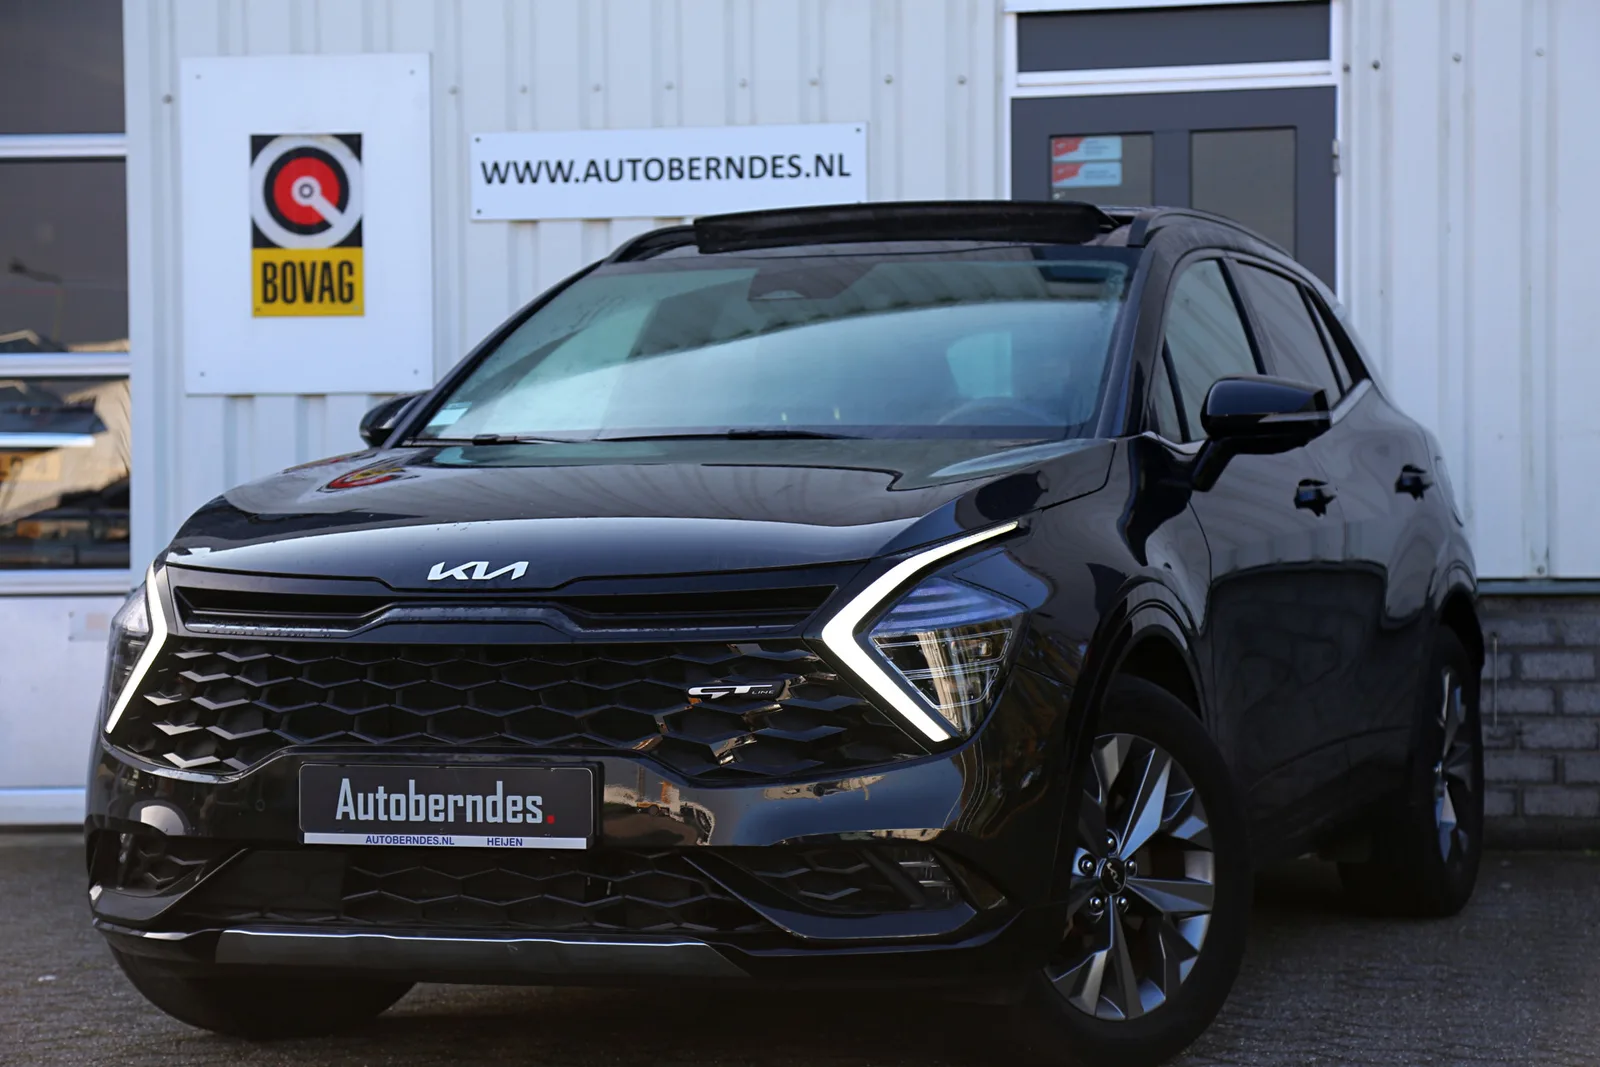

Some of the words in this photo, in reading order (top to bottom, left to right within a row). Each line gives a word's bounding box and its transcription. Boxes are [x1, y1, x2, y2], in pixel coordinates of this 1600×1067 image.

[481, 153, 852, 185] WWW.AUTOBERNDES.NL
[261, 260, 355, 304] BOVAG
[427, 561, 529, 580] KIA
[365, 835, 455, 847] AUTOBERNDES.NL
[486, 837, 523, 847] HEIJEN
